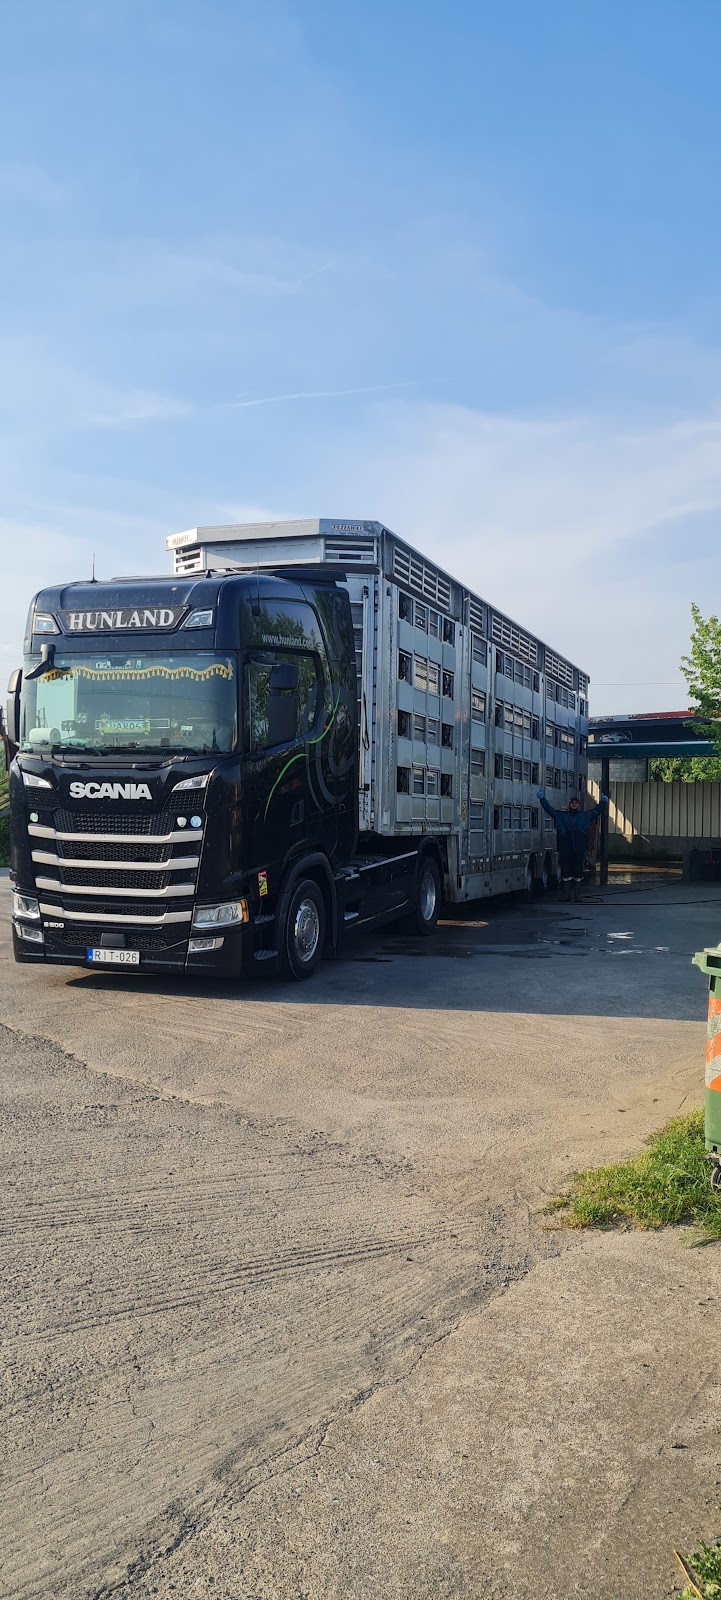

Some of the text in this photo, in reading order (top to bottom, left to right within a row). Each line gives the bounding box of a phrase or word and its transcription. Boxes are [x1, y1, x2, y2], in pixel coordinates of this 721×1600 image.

[69, 609, 175, 630] HUNLAND
[69, 781, 153, 800] SCANIA
[94, 950, 138, 963] RIT-026
